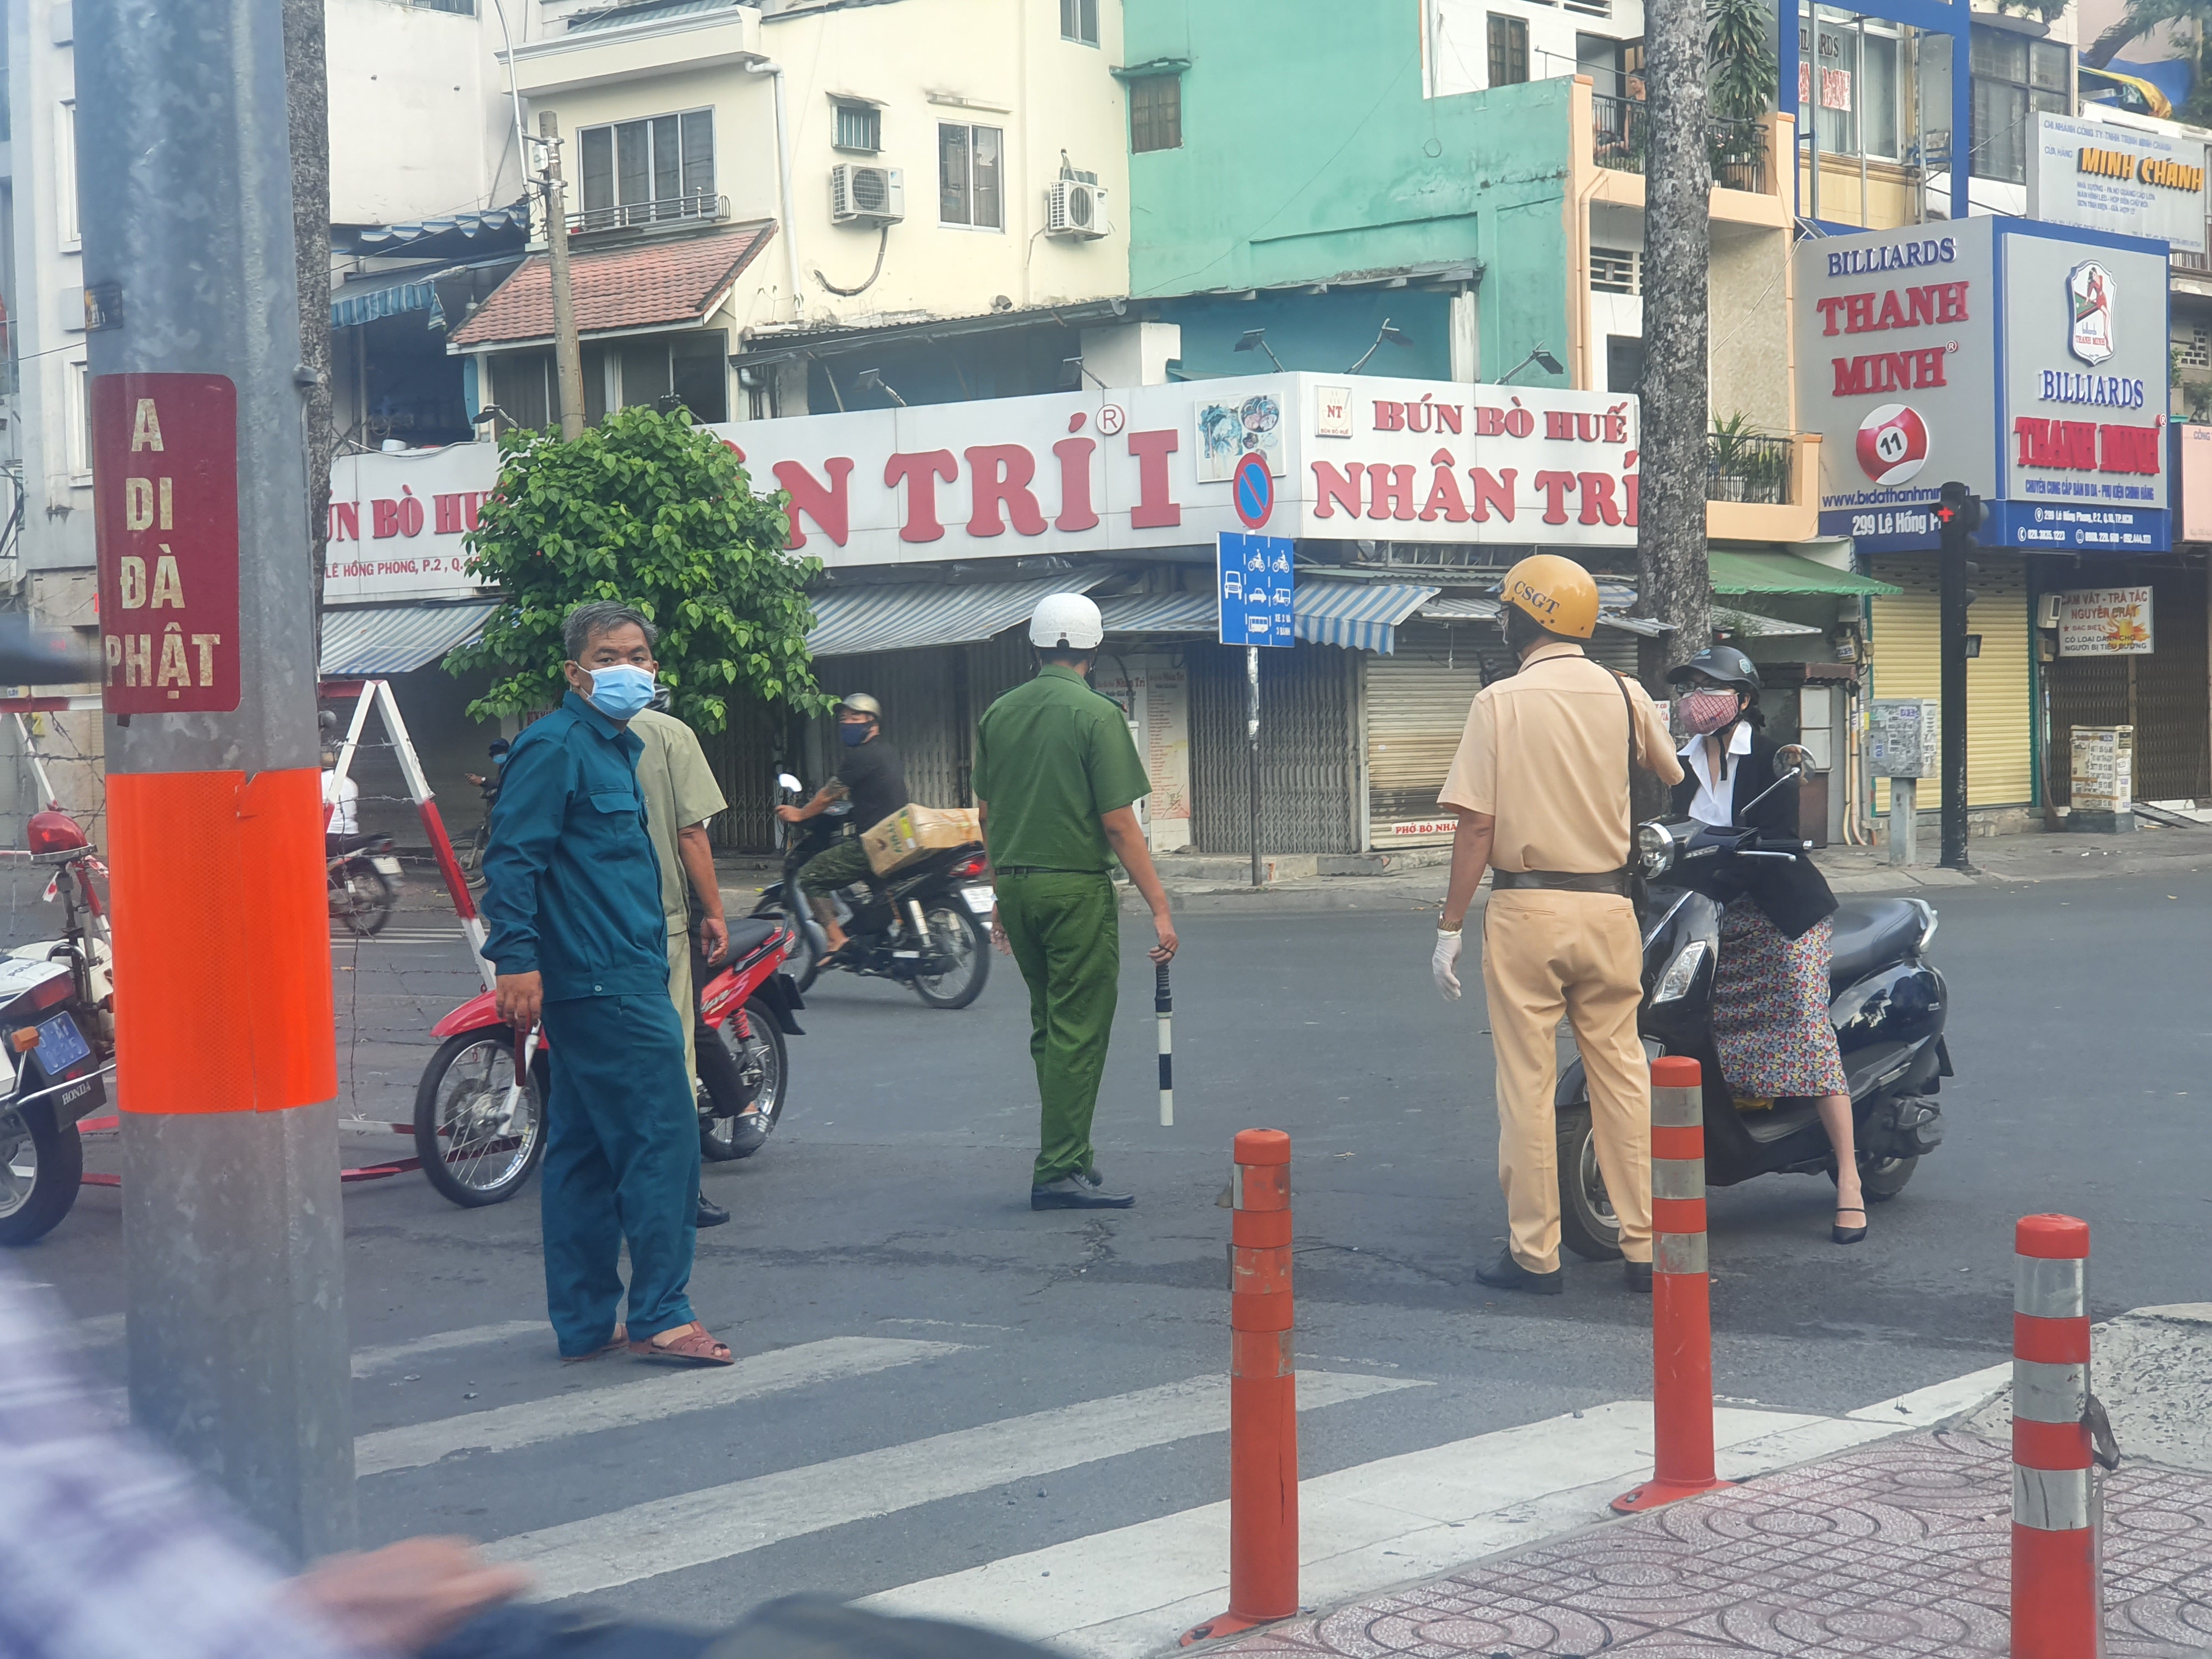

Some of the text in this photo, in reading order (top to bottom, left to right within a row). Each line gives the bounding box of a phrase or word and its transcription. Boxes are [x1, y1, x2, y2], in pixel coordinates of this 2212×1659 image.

[2079, 147, 2204, 192] MINH CHÁNH
[1827, 238, 1957, 277] BILLIARDS
[1816, 280, 1970, 336] THANH
[2075, 335, 2105, 346] THANH MINH
[1832, 346, 1947, 397] MINH
[2041, 370, 2144, 408] BILLIARDS
[131, 398, 165, 452] A
[1327, 405, 1342, 418] NT
[1373, 393, 1628, 443] BÚN BÒ HUẾ
[1880, 432, 1902, 455] 11
[2015, 416, 2160, 474] THANH MINH
[884, 411, 1100, 543] TRÍ
[1127, 429, 1181, 529] I
[1311, 447, 1639, 526] NHÂN TRÍ
[126, 477, 173, 531] DI
[370, 483, 424, 539] BÒ
[432, 483, 507, 535] HU
[1852, 514, 1875, 536] 299
[1878, 512, 1893, 534] Lê
[120, 544, 185, 609] ĐÀ
[325, 562, 339, 578] LÊ
[377, 560, 419, 575] PHONG,
[1514, 580, 1560, 615] CSGT
[2108, 590, 2126, 603] TRÀ
[1274, 614, 1281, 623] XE
[1282, 614, 1285, 623] 2
[1276, 624, 1291, 636] 3 BÁNH
[105, 622, 221, 699] PHẬT
[2092, 644, 2098, 652] BỊ
[1396, 821, 1457, 834] PHỞ BÒ NHÂ
[61, 1081, 91, 1105] HONDA
